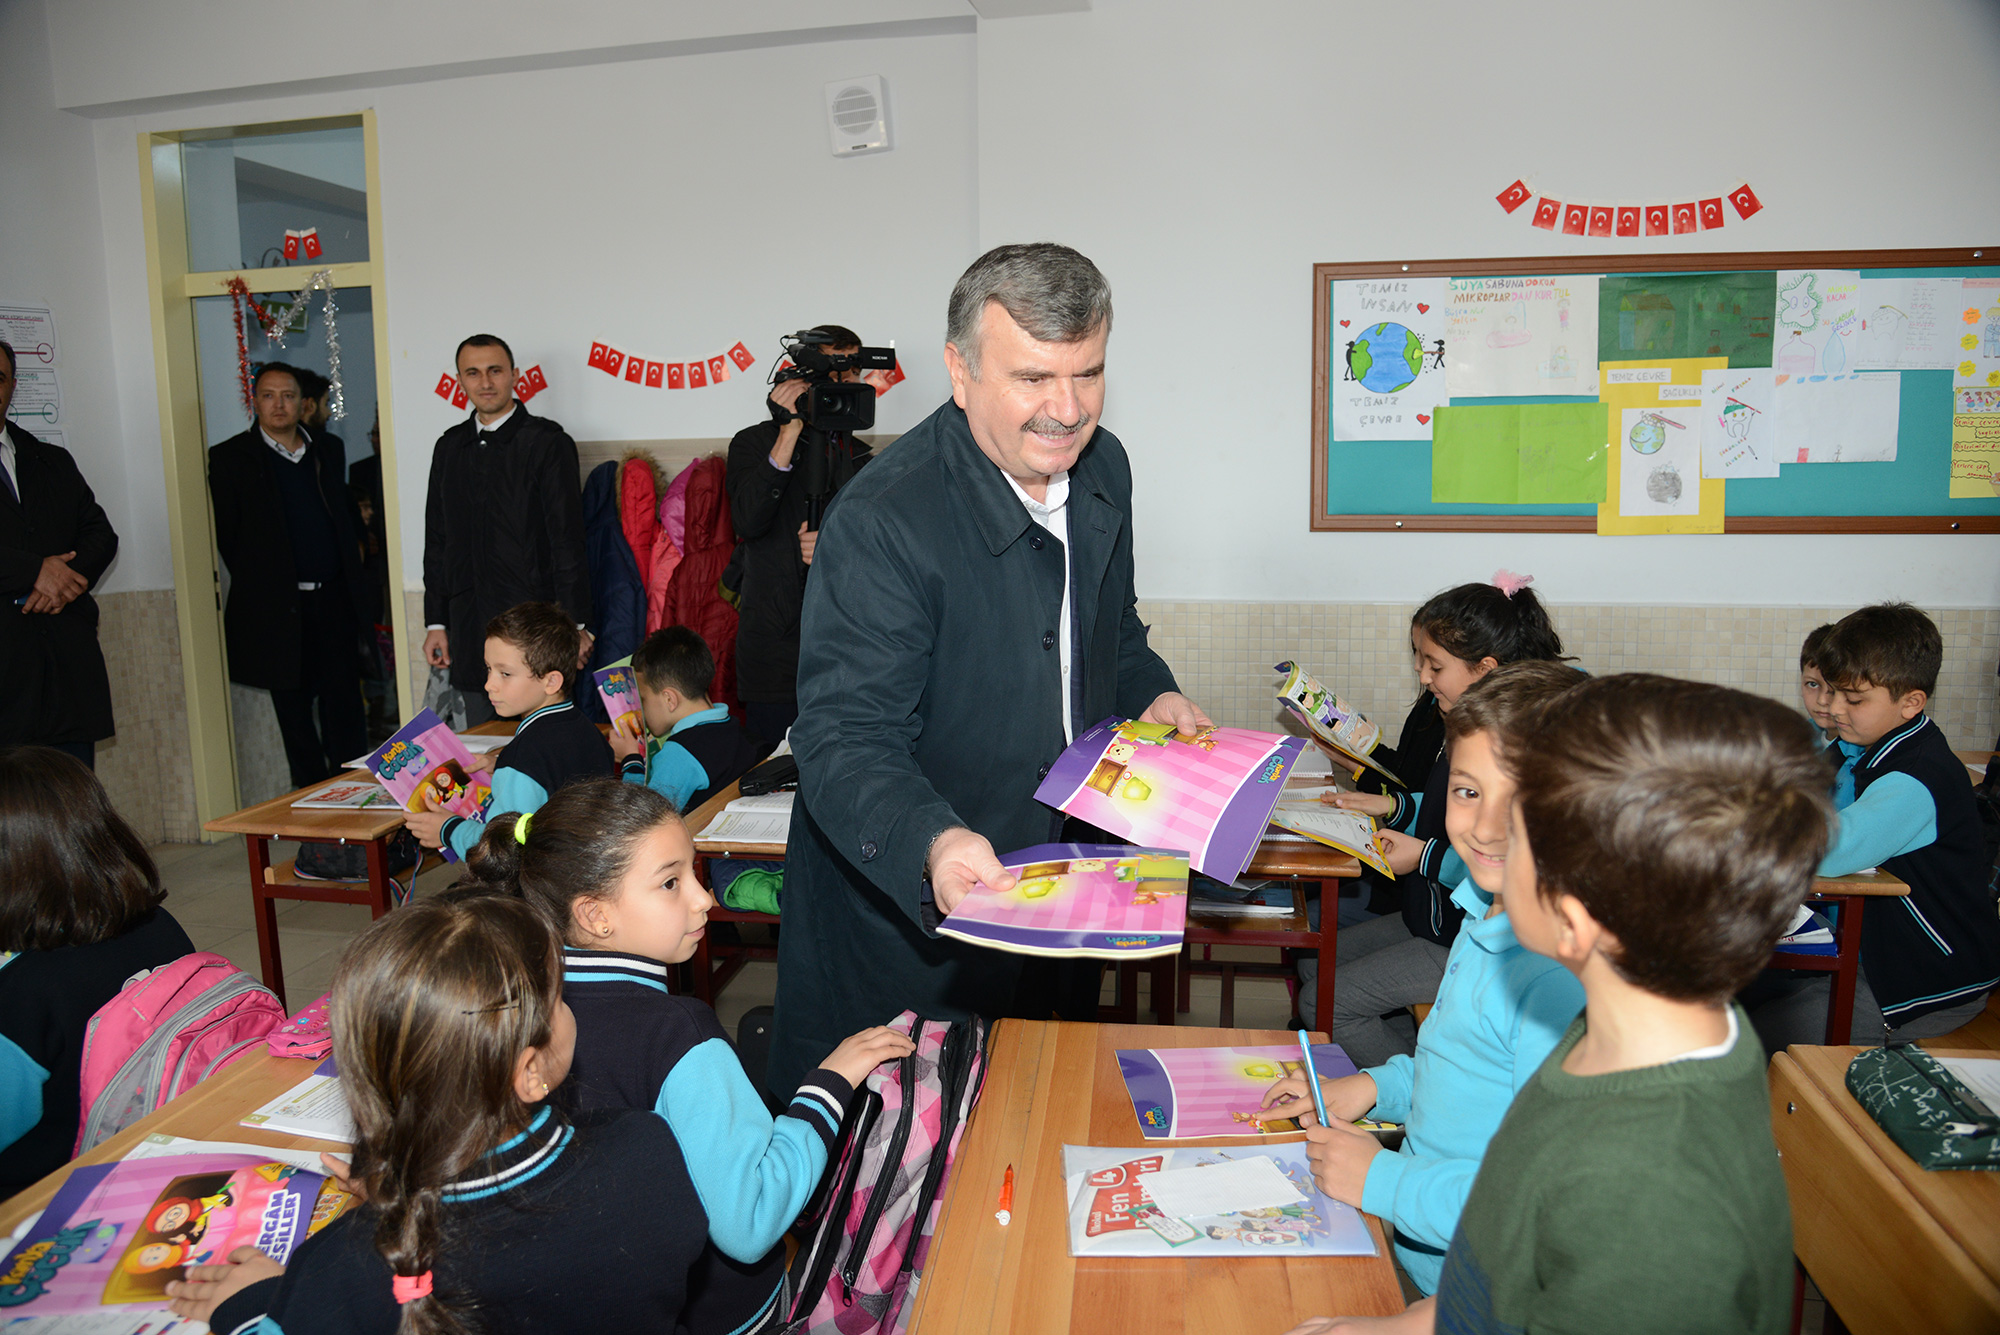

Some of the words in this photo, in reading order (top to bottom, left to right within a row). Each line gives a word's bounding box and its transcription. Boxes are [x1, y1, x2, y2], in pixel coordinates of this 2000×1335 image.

[1448, 279, 1483, 291] SUYA
[1485, 278, 1524, 289] SABUNA
[1091, 1171, 1116, 1185] 4
[1105, 1192, 1131, 1224] Fen
